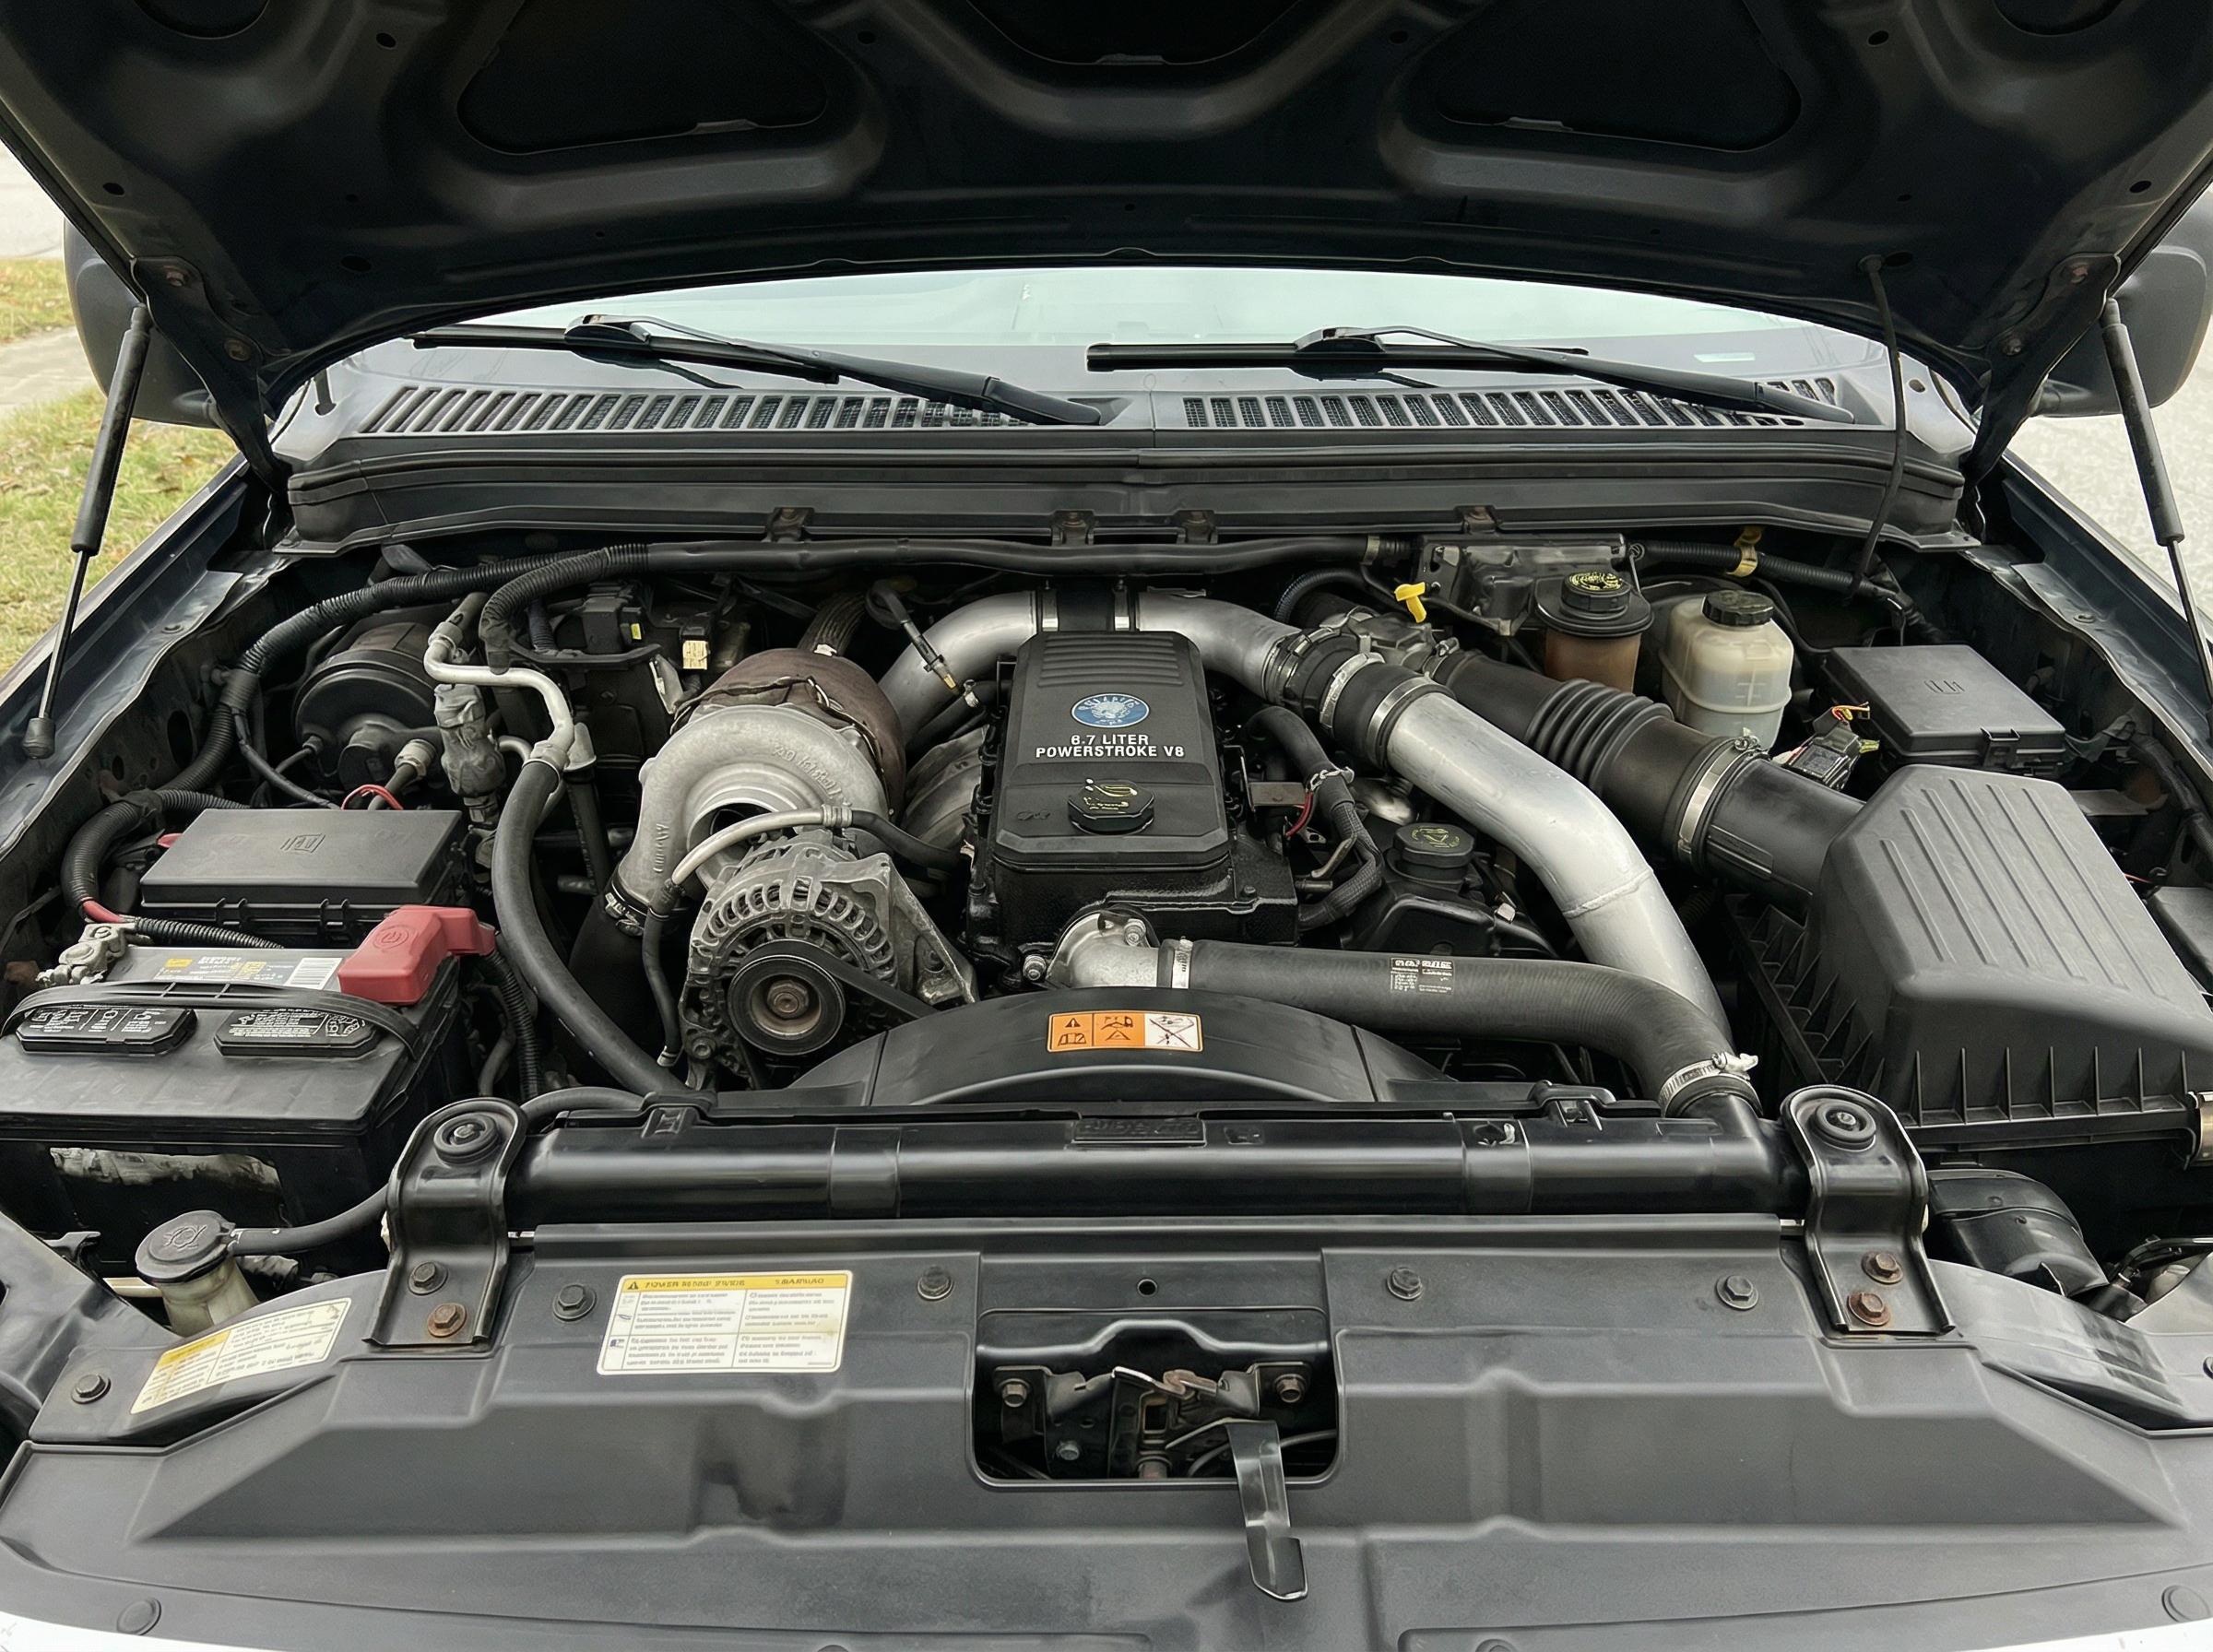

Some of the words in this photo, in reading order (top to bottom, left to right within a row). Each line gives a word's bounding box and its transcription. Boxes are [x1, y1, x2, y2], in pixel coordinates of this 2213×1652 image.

[1102, 734, 1149, 746] LITER
[1035, 745, 1157, 758] POWERSTROKE
[1164, 745, 1185, 757] V8
